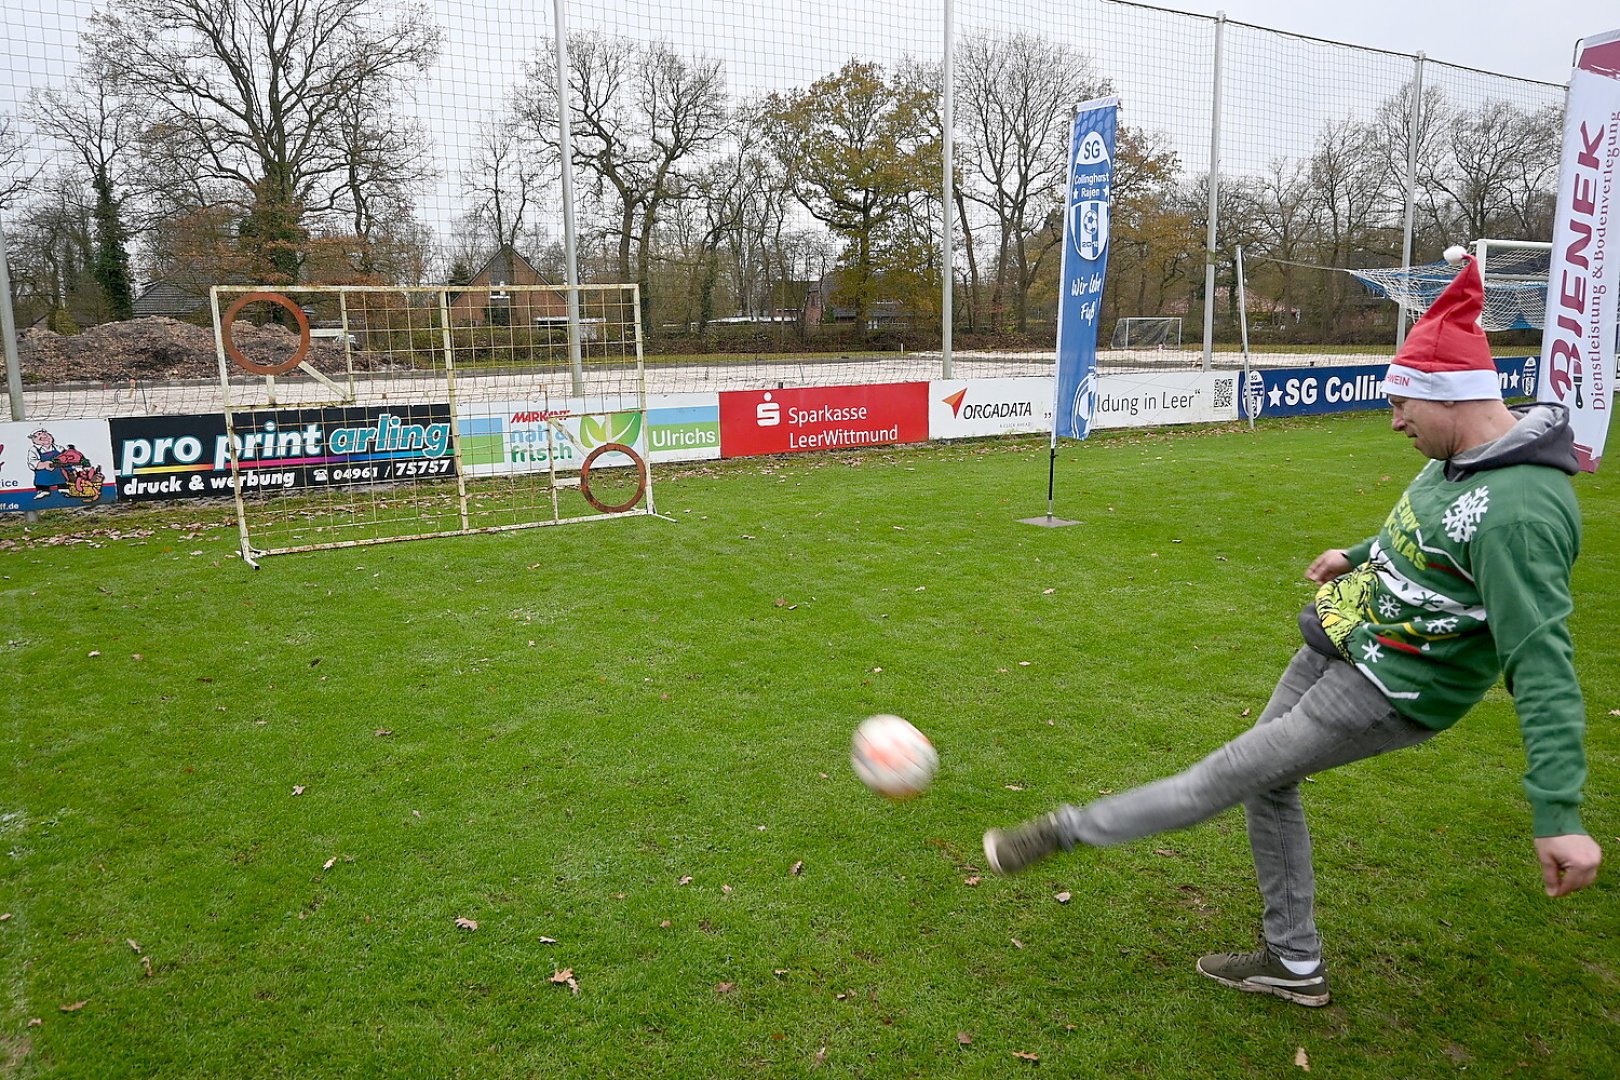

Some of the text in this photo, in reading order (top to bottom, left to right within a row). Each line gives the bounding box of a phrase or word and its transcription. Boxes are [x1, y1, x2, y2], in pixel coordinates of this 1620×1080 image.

[1083, 139, 1101, 160] SG
[1081, 187, 1100, 199] Rajen
[1549, 120, 1605, 402] BIENEK
[1587, 110, 1620, 410] Dienstleistung & Bodenverlegung
[1071, 276, 1088, 296] Wir
[1284, 377, 1318, 406] SG
[1324, 374, 1390, 405] Collin
[788, 405, 867, 427] Sparkasse
[1096, 393, 1139, 416] ldung
[1144, 393, 1157, 410] in
[121, 413, 451, 477] pro print arling
[652, 428, 717, 447] Ulrichs
[789, 424, 898, 449] LeerWittmund
[333, 466, 379, 480] 04961
[395, 459, 451, 476] 75757
[0, 478, 19, 488] ice
[123, 470, 296, 495] druck & werbung
[1398, 492, 1421, 533] ERRY
